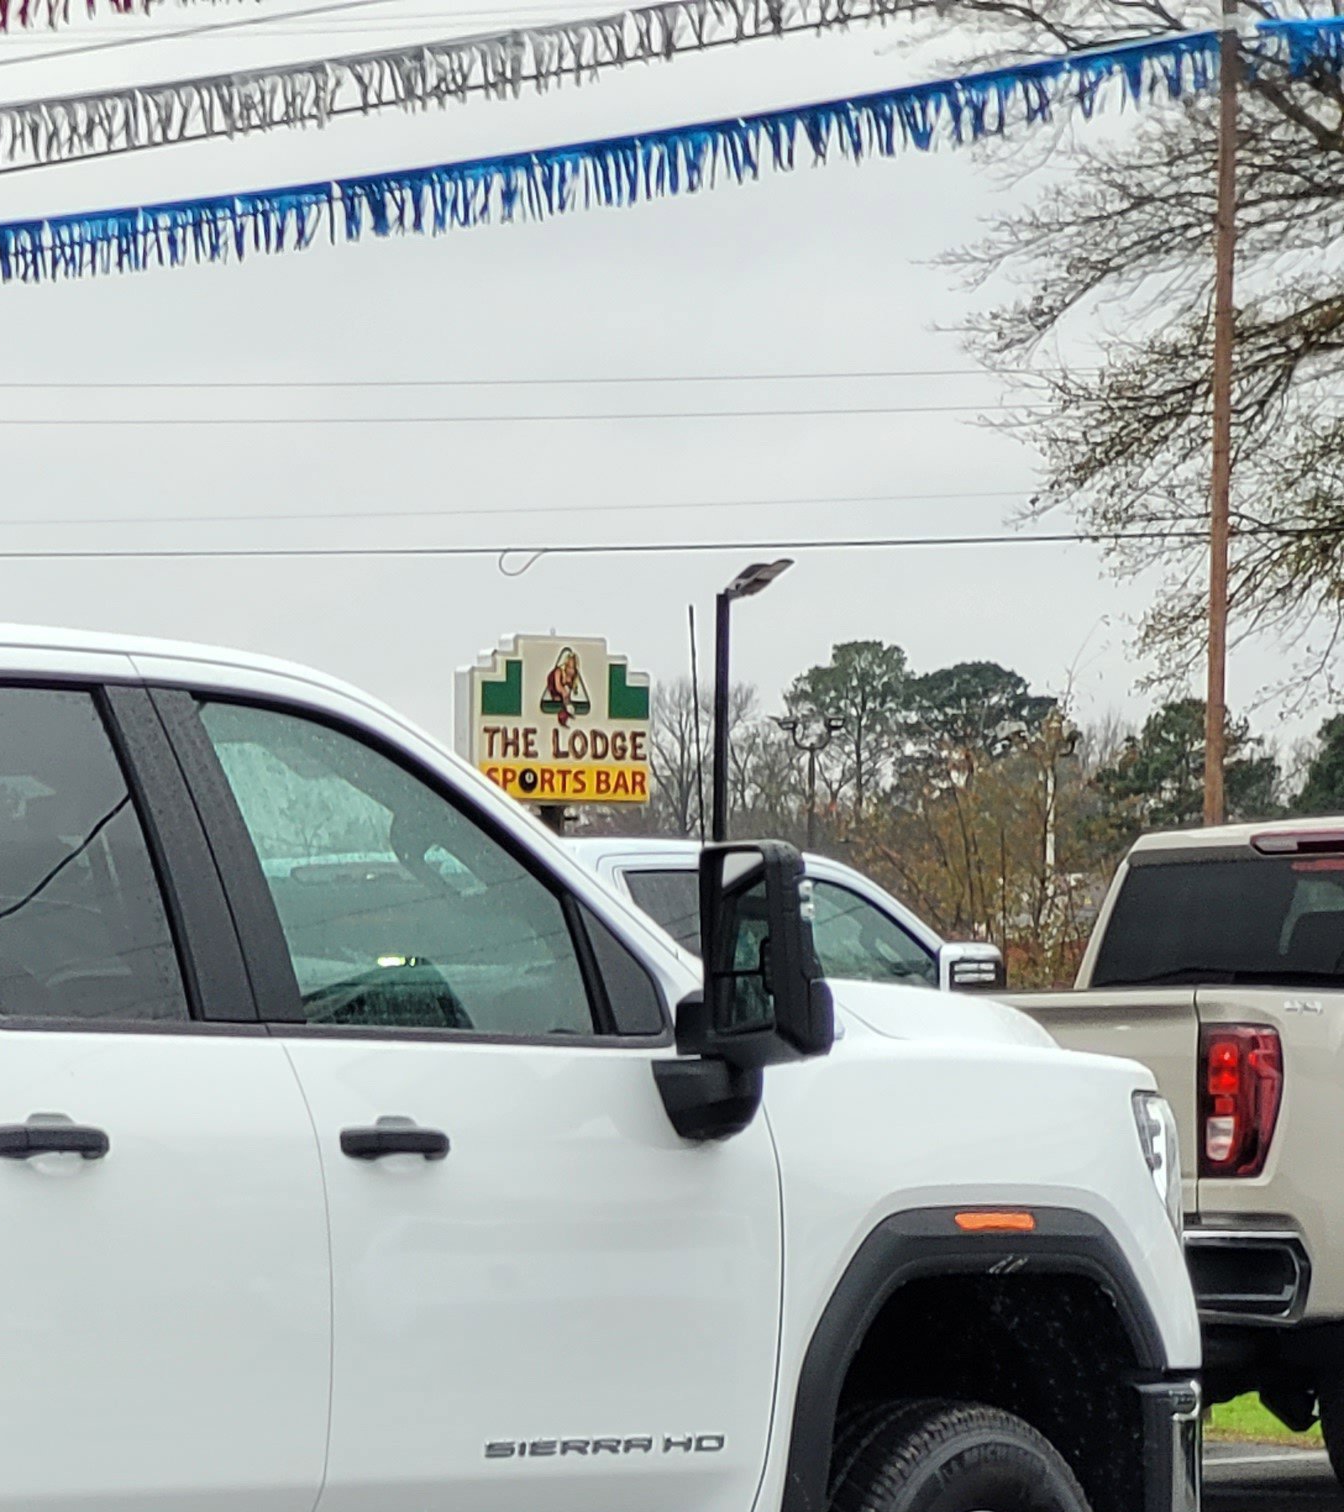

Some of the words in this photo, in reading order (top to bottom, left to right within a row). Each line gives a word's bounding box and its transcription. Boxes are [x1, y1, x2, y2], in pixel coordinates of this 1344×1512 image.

[483, 726, 539, 758] THE
[552, 728, 648, 761] LODGE
[595, 770, 647, 796] BAR
[484, 1435, 653, 1458] SIERRA
[662, 1433, 725, 1454] HD
